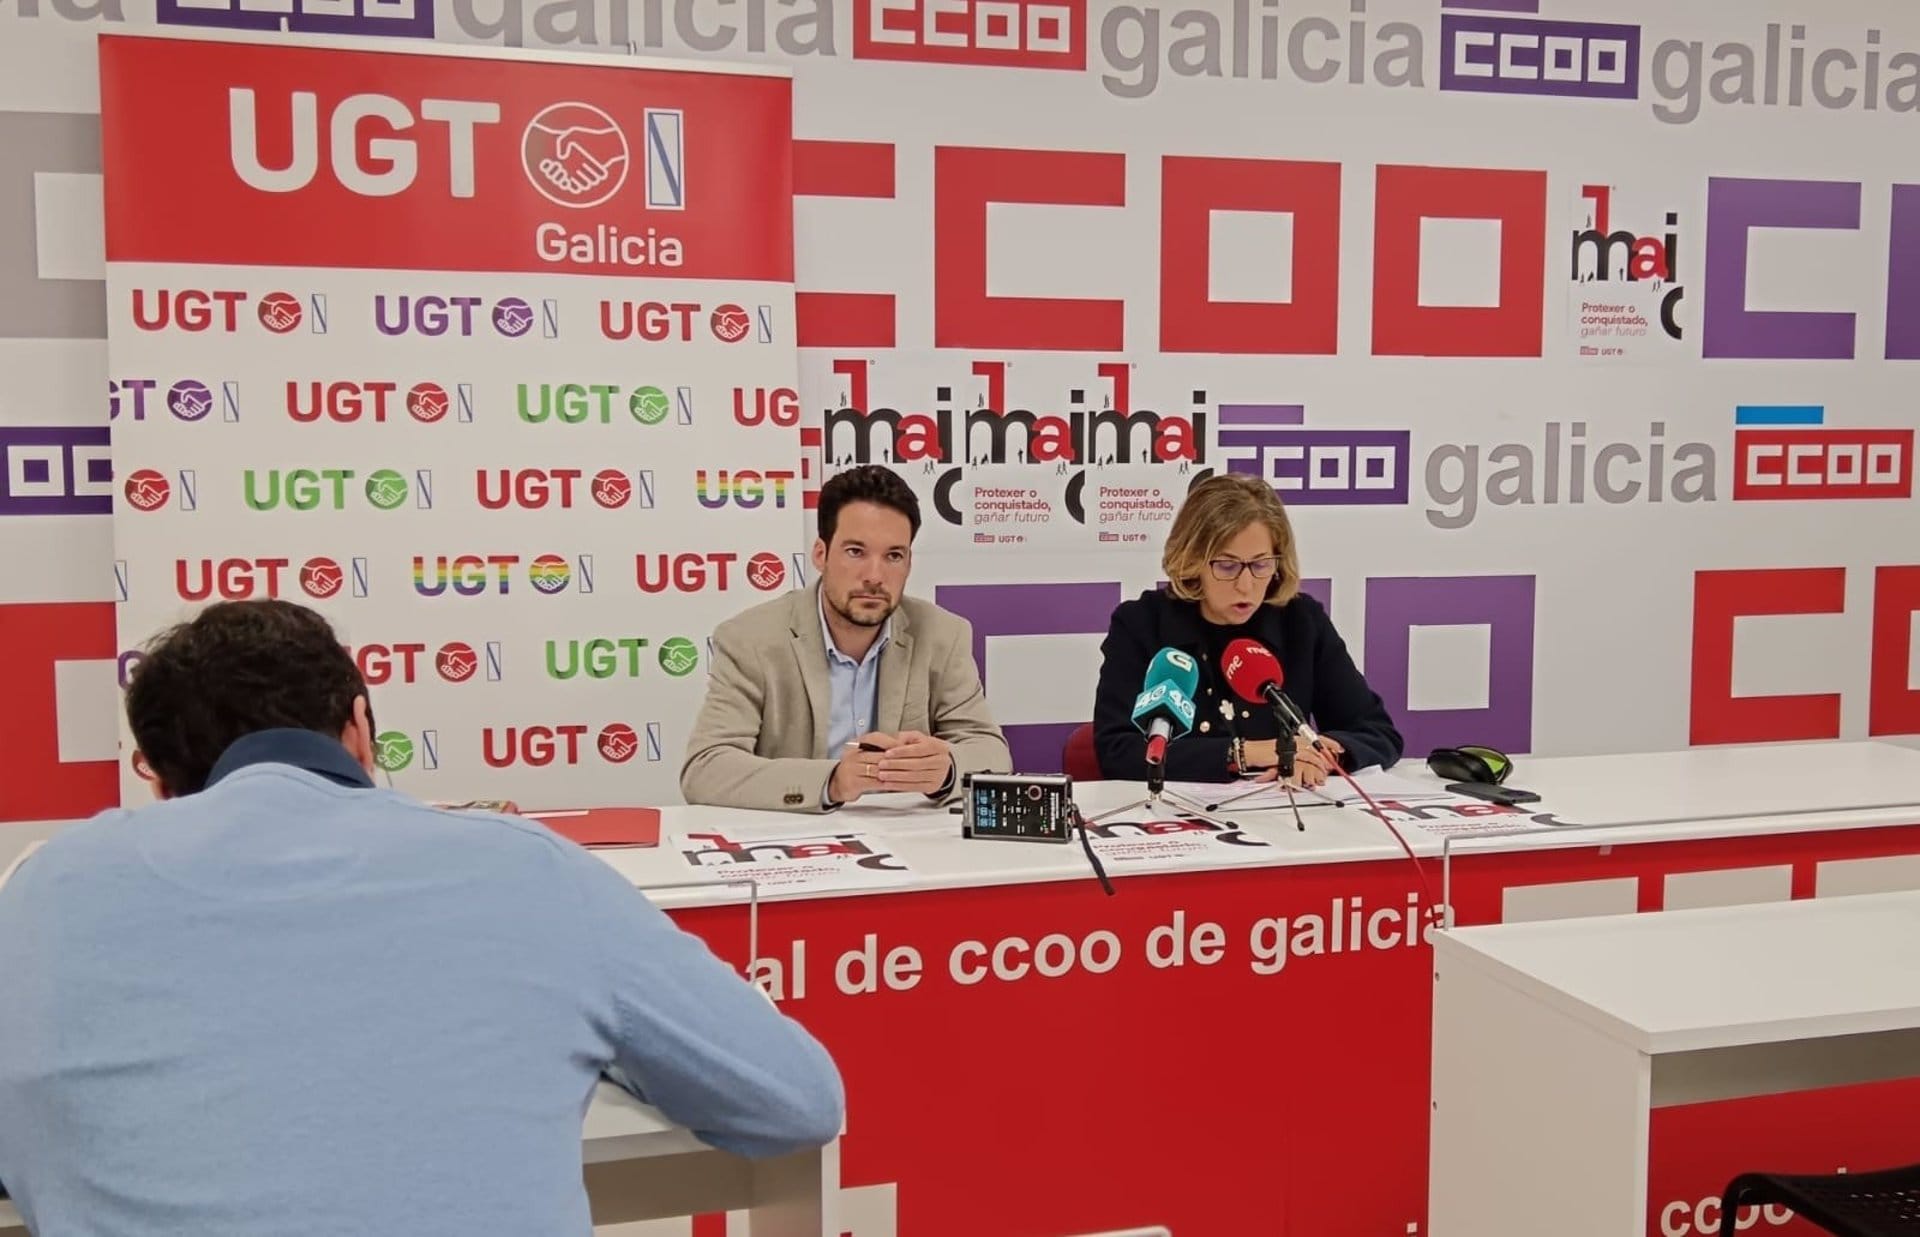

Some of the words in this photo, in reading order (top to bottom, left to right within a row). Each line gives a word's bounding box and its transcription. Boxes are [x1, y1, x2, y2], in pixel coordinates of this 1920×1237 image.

[1101, 0, 1425, 98] galicia
[229, 88, 500, 197] UGT
[535, 221, 684, 266] Galicia
[132, 289, 247, 332] UGT
[375, 295, 482, 336] UGT
[600, 300, 702, 341] UGT
[1581, 315, 1649, 327] conquistado,
[1582, 303, 1625, 313] Protexer
[287, 381, 396, 423] UGT
[517, 383, 620, 424] UGT
[244, 469, 355, 511] UGT
[476, 469, 582, 510] UGT
[696, 470, 795, 509] UGT
[975, 487, 1025, 498] Protexer
[1029, 489, 1037, 498] o
[1100, 487, 1148, 498] Protexer
[1152, 489, 1160, 497] o
[1425, 421, 1717, 529] galicia
[974, 499, 1052, 512] conquistado,
[974, 511, 1010, 524] gañar
[1014, 511, 1050, 523] futuro
[1099, 498, 1174, 511] conquistado,
[1099, 511, 1133, 524] gañar
[1137, 510, 1172, 522] futuro
[176, 558, 289, 602] UGT
[413, 554, 520, 597] UGT
[635, 552, 738, 593] UGT
[344, 643, 426, 686] GT
[545, 637, 649, 680] UGT
[482, 724, 588, 768] UGT
[835, 934, 923, 995] de
[949, 930, 1122, 985] ccoo
[1146, 910, 1226, 969] de
